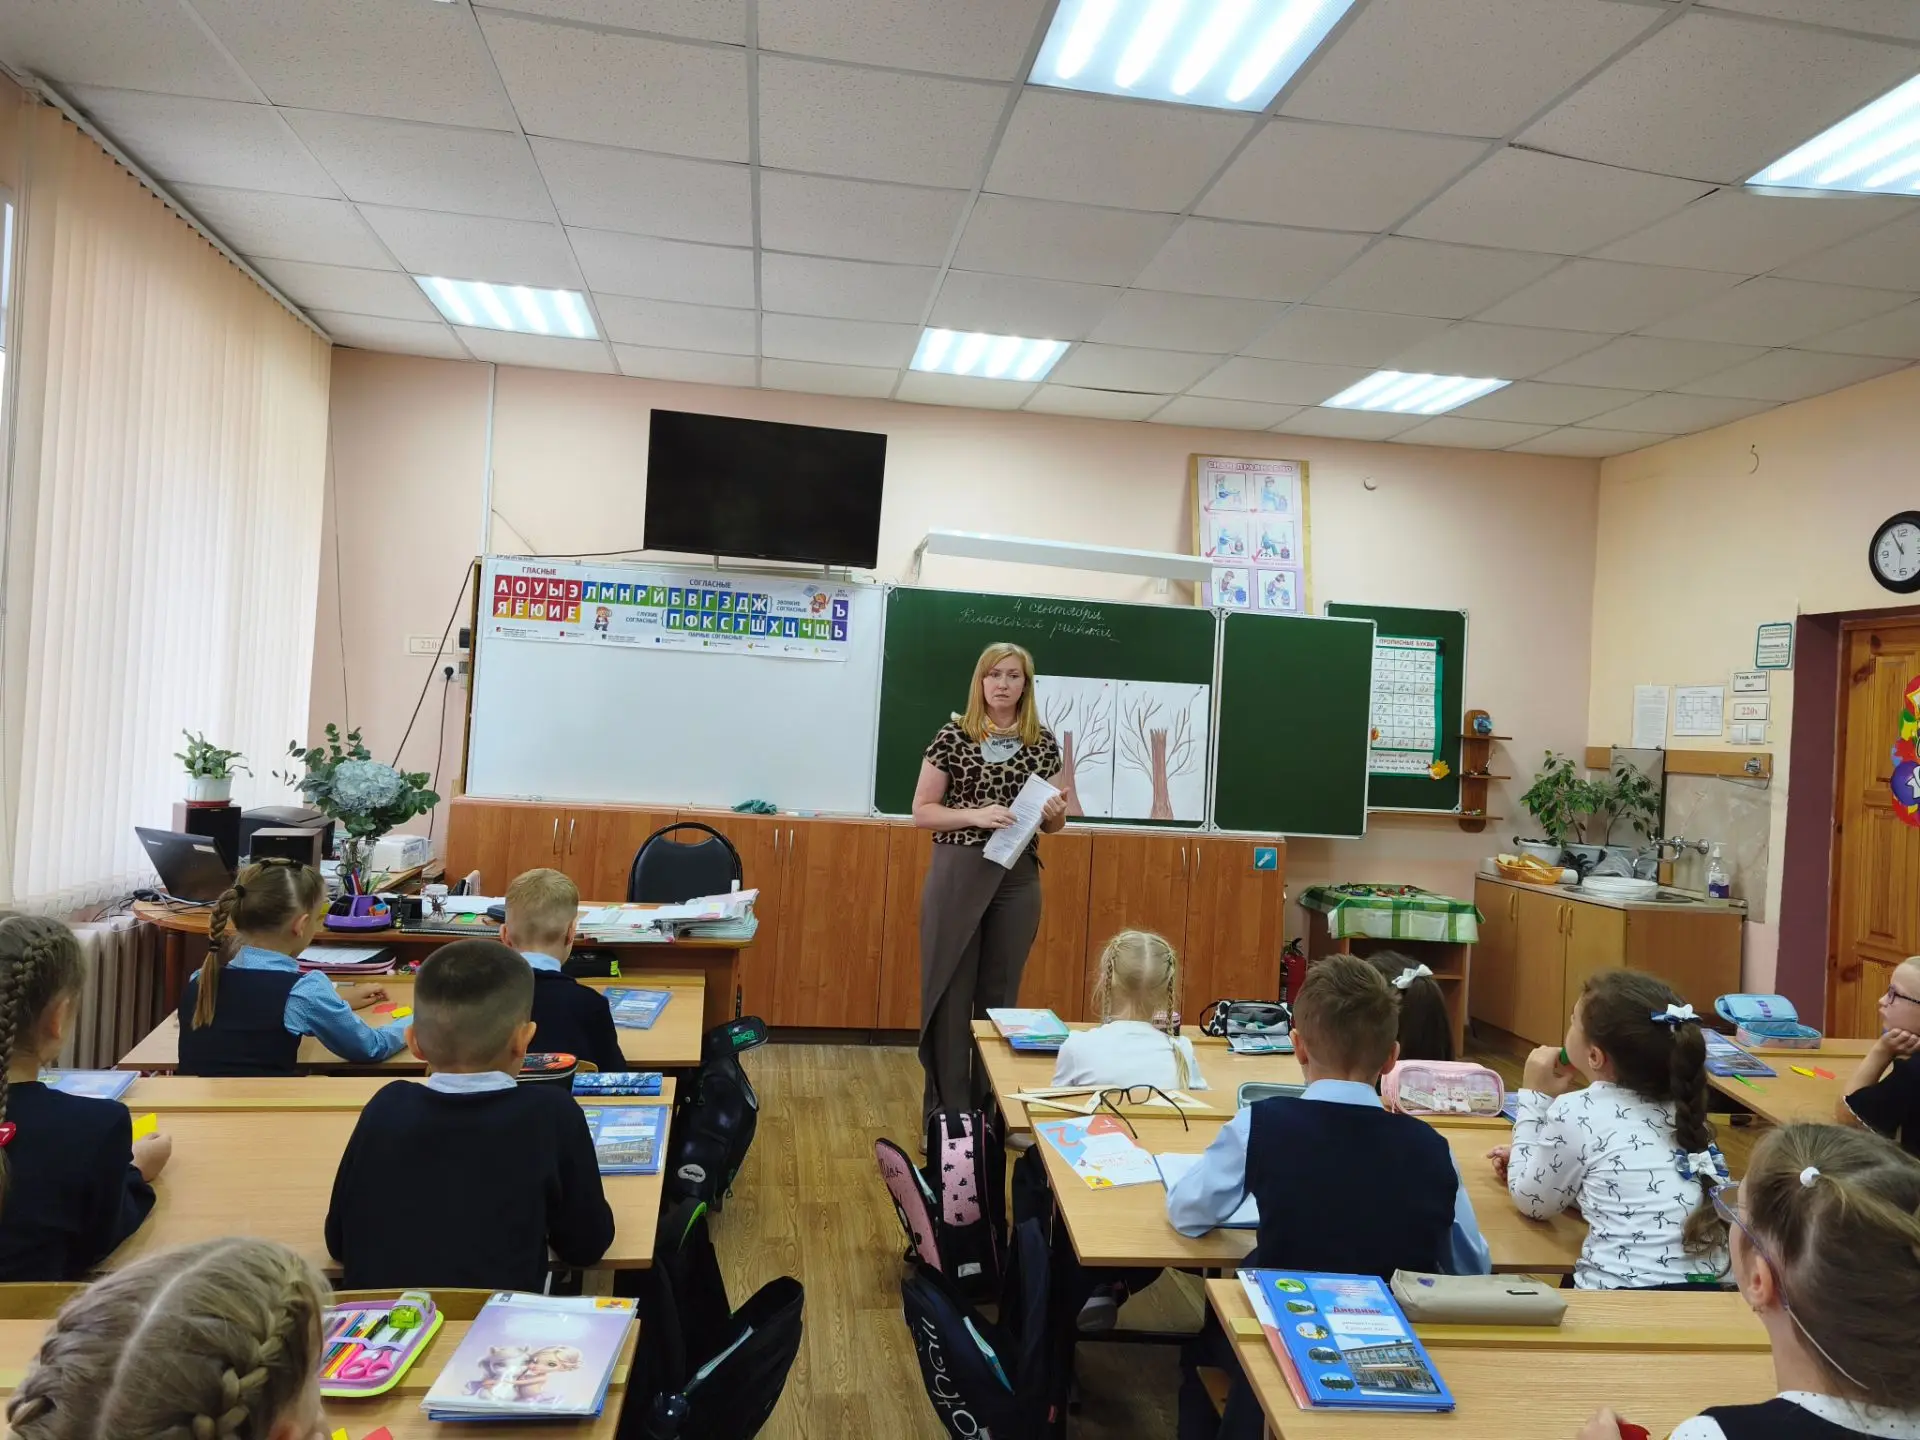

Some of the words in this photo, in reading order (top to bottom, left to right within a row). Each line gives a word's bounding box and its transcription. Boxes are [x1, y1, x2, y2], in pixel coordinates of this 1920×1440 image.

[1897, 528, 1908, 537] 12
[522, 566, 557, 575] ГЛАСНЫЕ
[1900, 568, 1908, 576] 6
[689, 578, 732, 588] СОГЛАСНЫЕ
[1012, 599, 1022, 612] 4
[834, 604, 846, 617] Ъ
